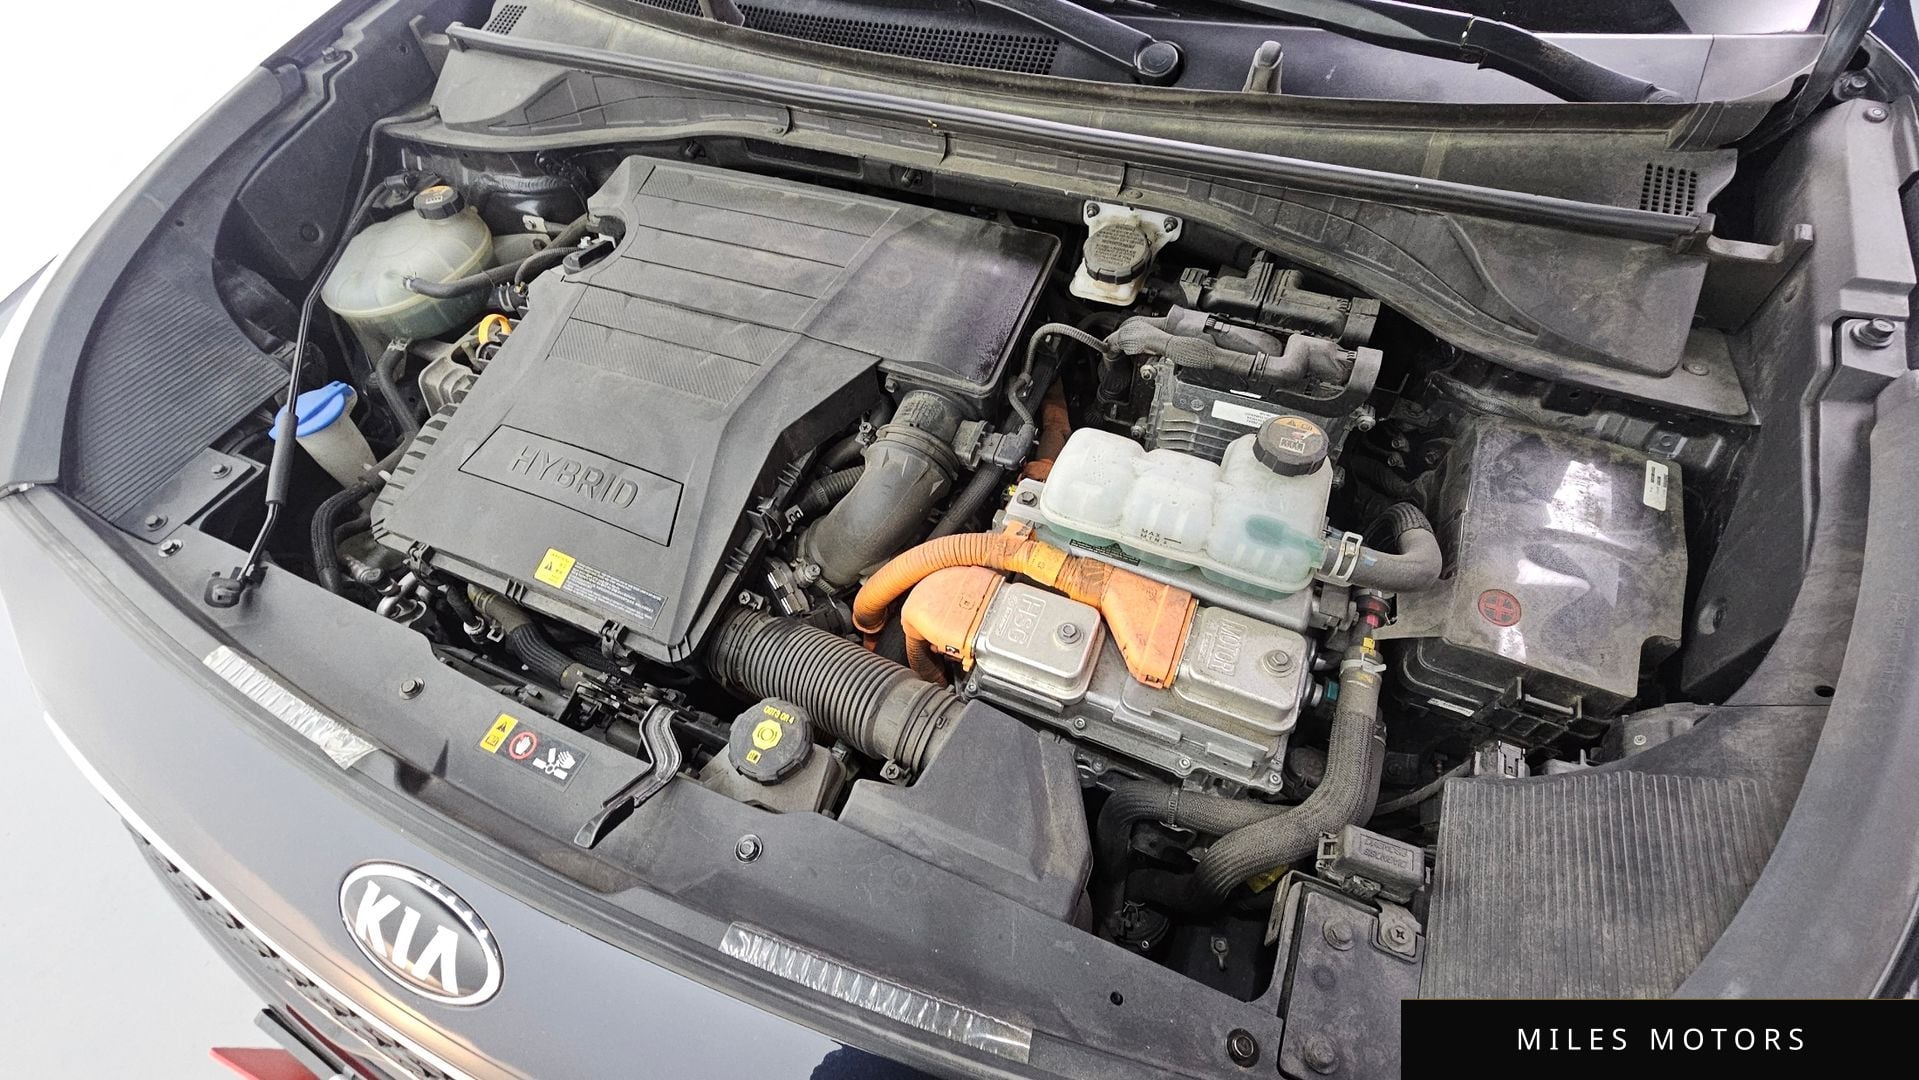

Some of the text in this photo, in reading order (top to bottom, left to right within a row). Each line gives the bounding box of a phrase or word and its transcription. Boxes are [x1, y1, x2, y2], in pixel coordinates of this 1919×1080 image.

[510, 445, 639, 510] HYBRID
[1007, 597, 1041, 645] HSG
[1211, 621, 1241, 672] MOTOR
[355, 879, 459, 996] KIA
